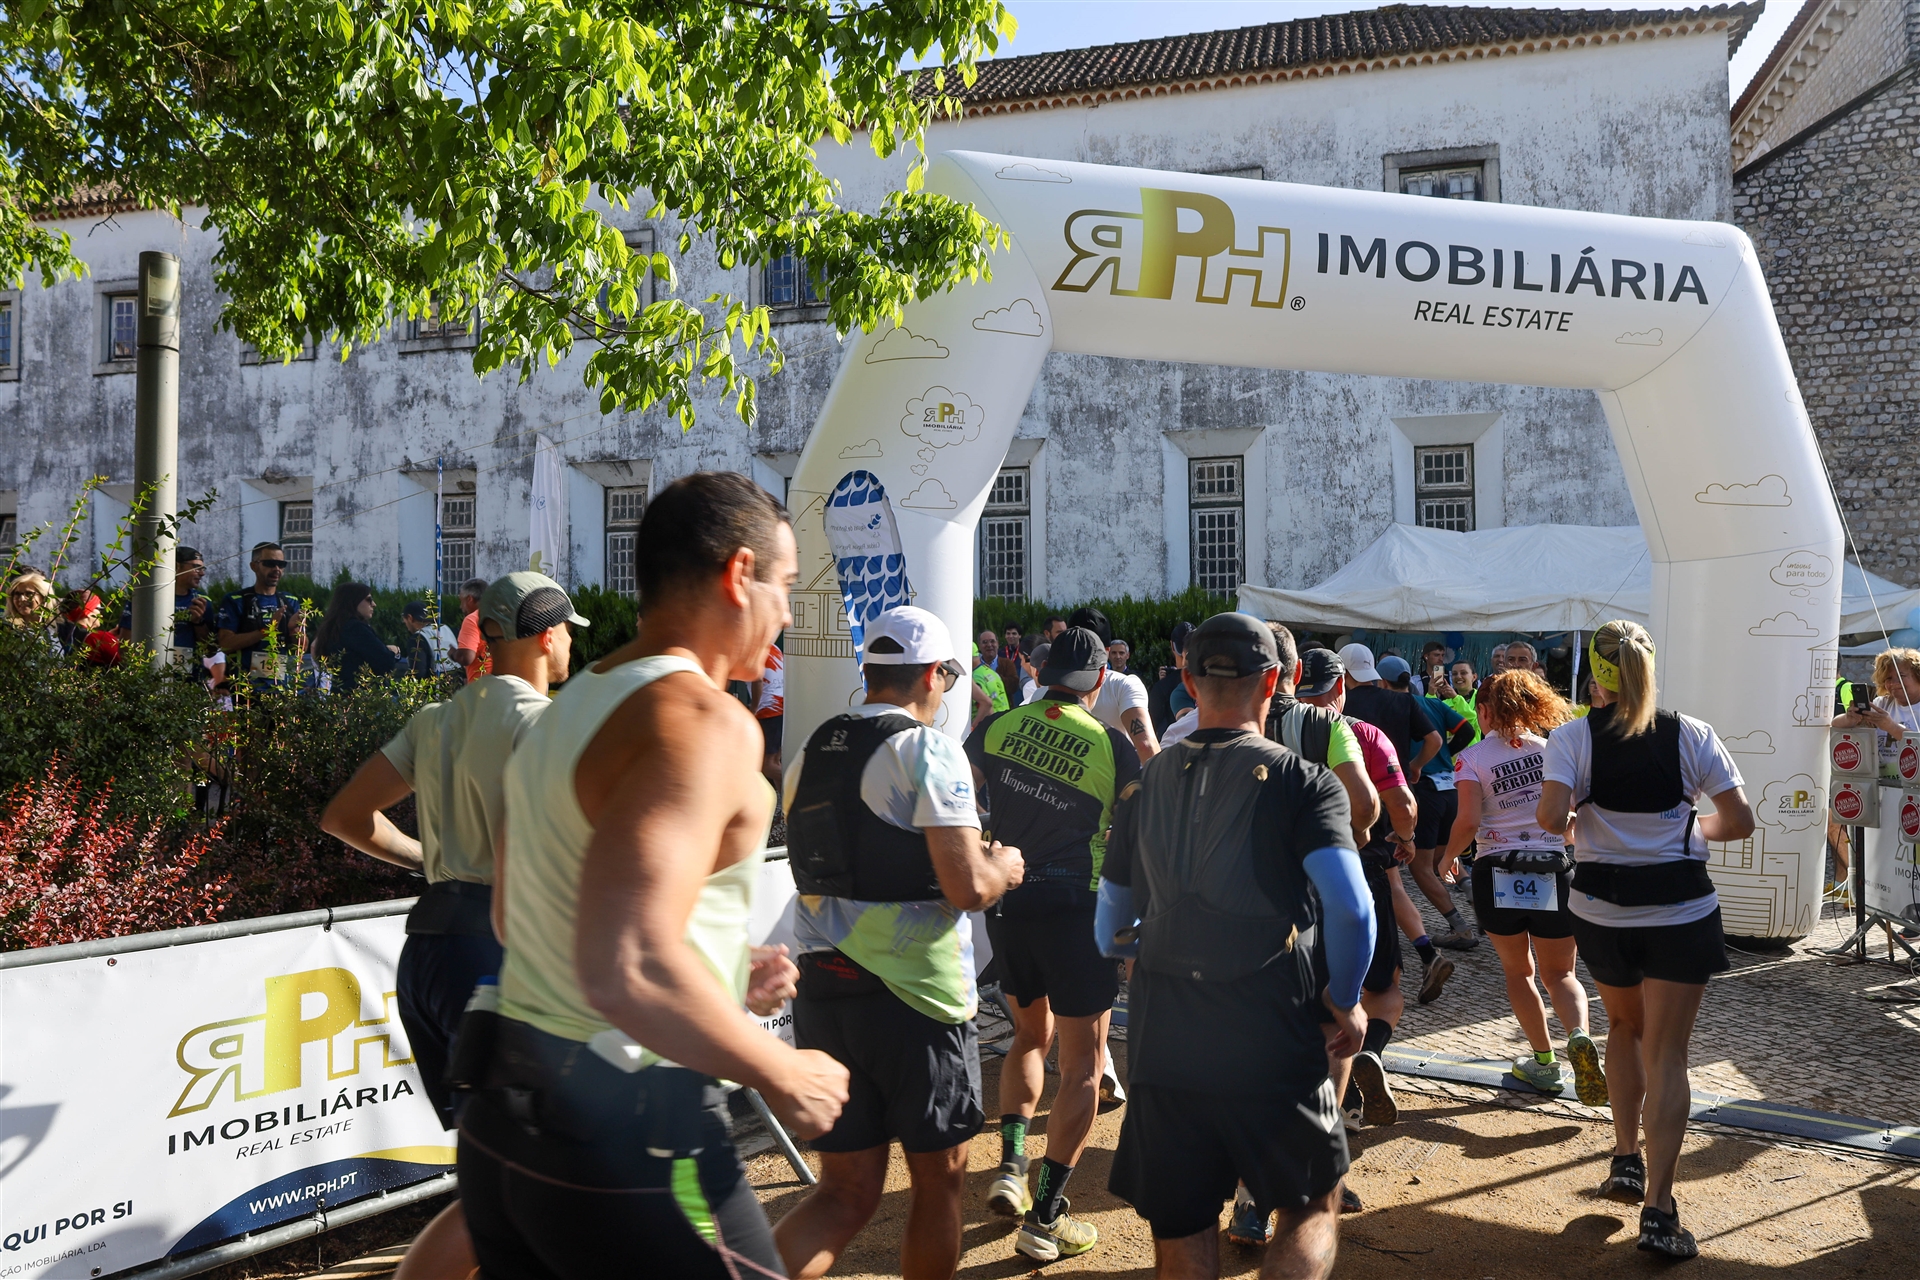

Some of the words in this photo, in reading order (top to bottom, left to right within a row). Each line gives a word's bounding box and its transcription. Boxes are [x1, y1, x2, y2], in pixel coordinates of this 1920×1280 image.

[1317, 233, 1709, 305] IMOBILIÁRIA
[1413, 300, 1475, 326] REAL
[1482, 306, 1573, 332] ESTATE
[1807, 570, 1826, 578] todos
[1018, 717, 1090, 758] TRILHO
[999, 736, 1084, 782] PERDIDO
[1491, 754, 1543, 778] TRILHO
[1513, 879, 1538, 896] 64
[772, 1014, 792, 1029] POR
[1536, 1069, 1552, 1077] HOKA
[168, 1079, 414, 1155] IMOBILIÁRIA
[236, 1137, 283, 1160] REAL
[290, 1118, 354, 1146] ESTATE
[1625, 1166, 1640, 1174] FILA
[249, 1171, 358, 1215] WWW.RPH.PT
[0, 1224, 47, 1251] QUI
[55, 1208, 106, 1236] POR
[113, 1200, 133, 1219] SI
[24, 1247, 86, 1270] IMOBILIÁRIA,
[88, 1241, 107, 1253] LDA
